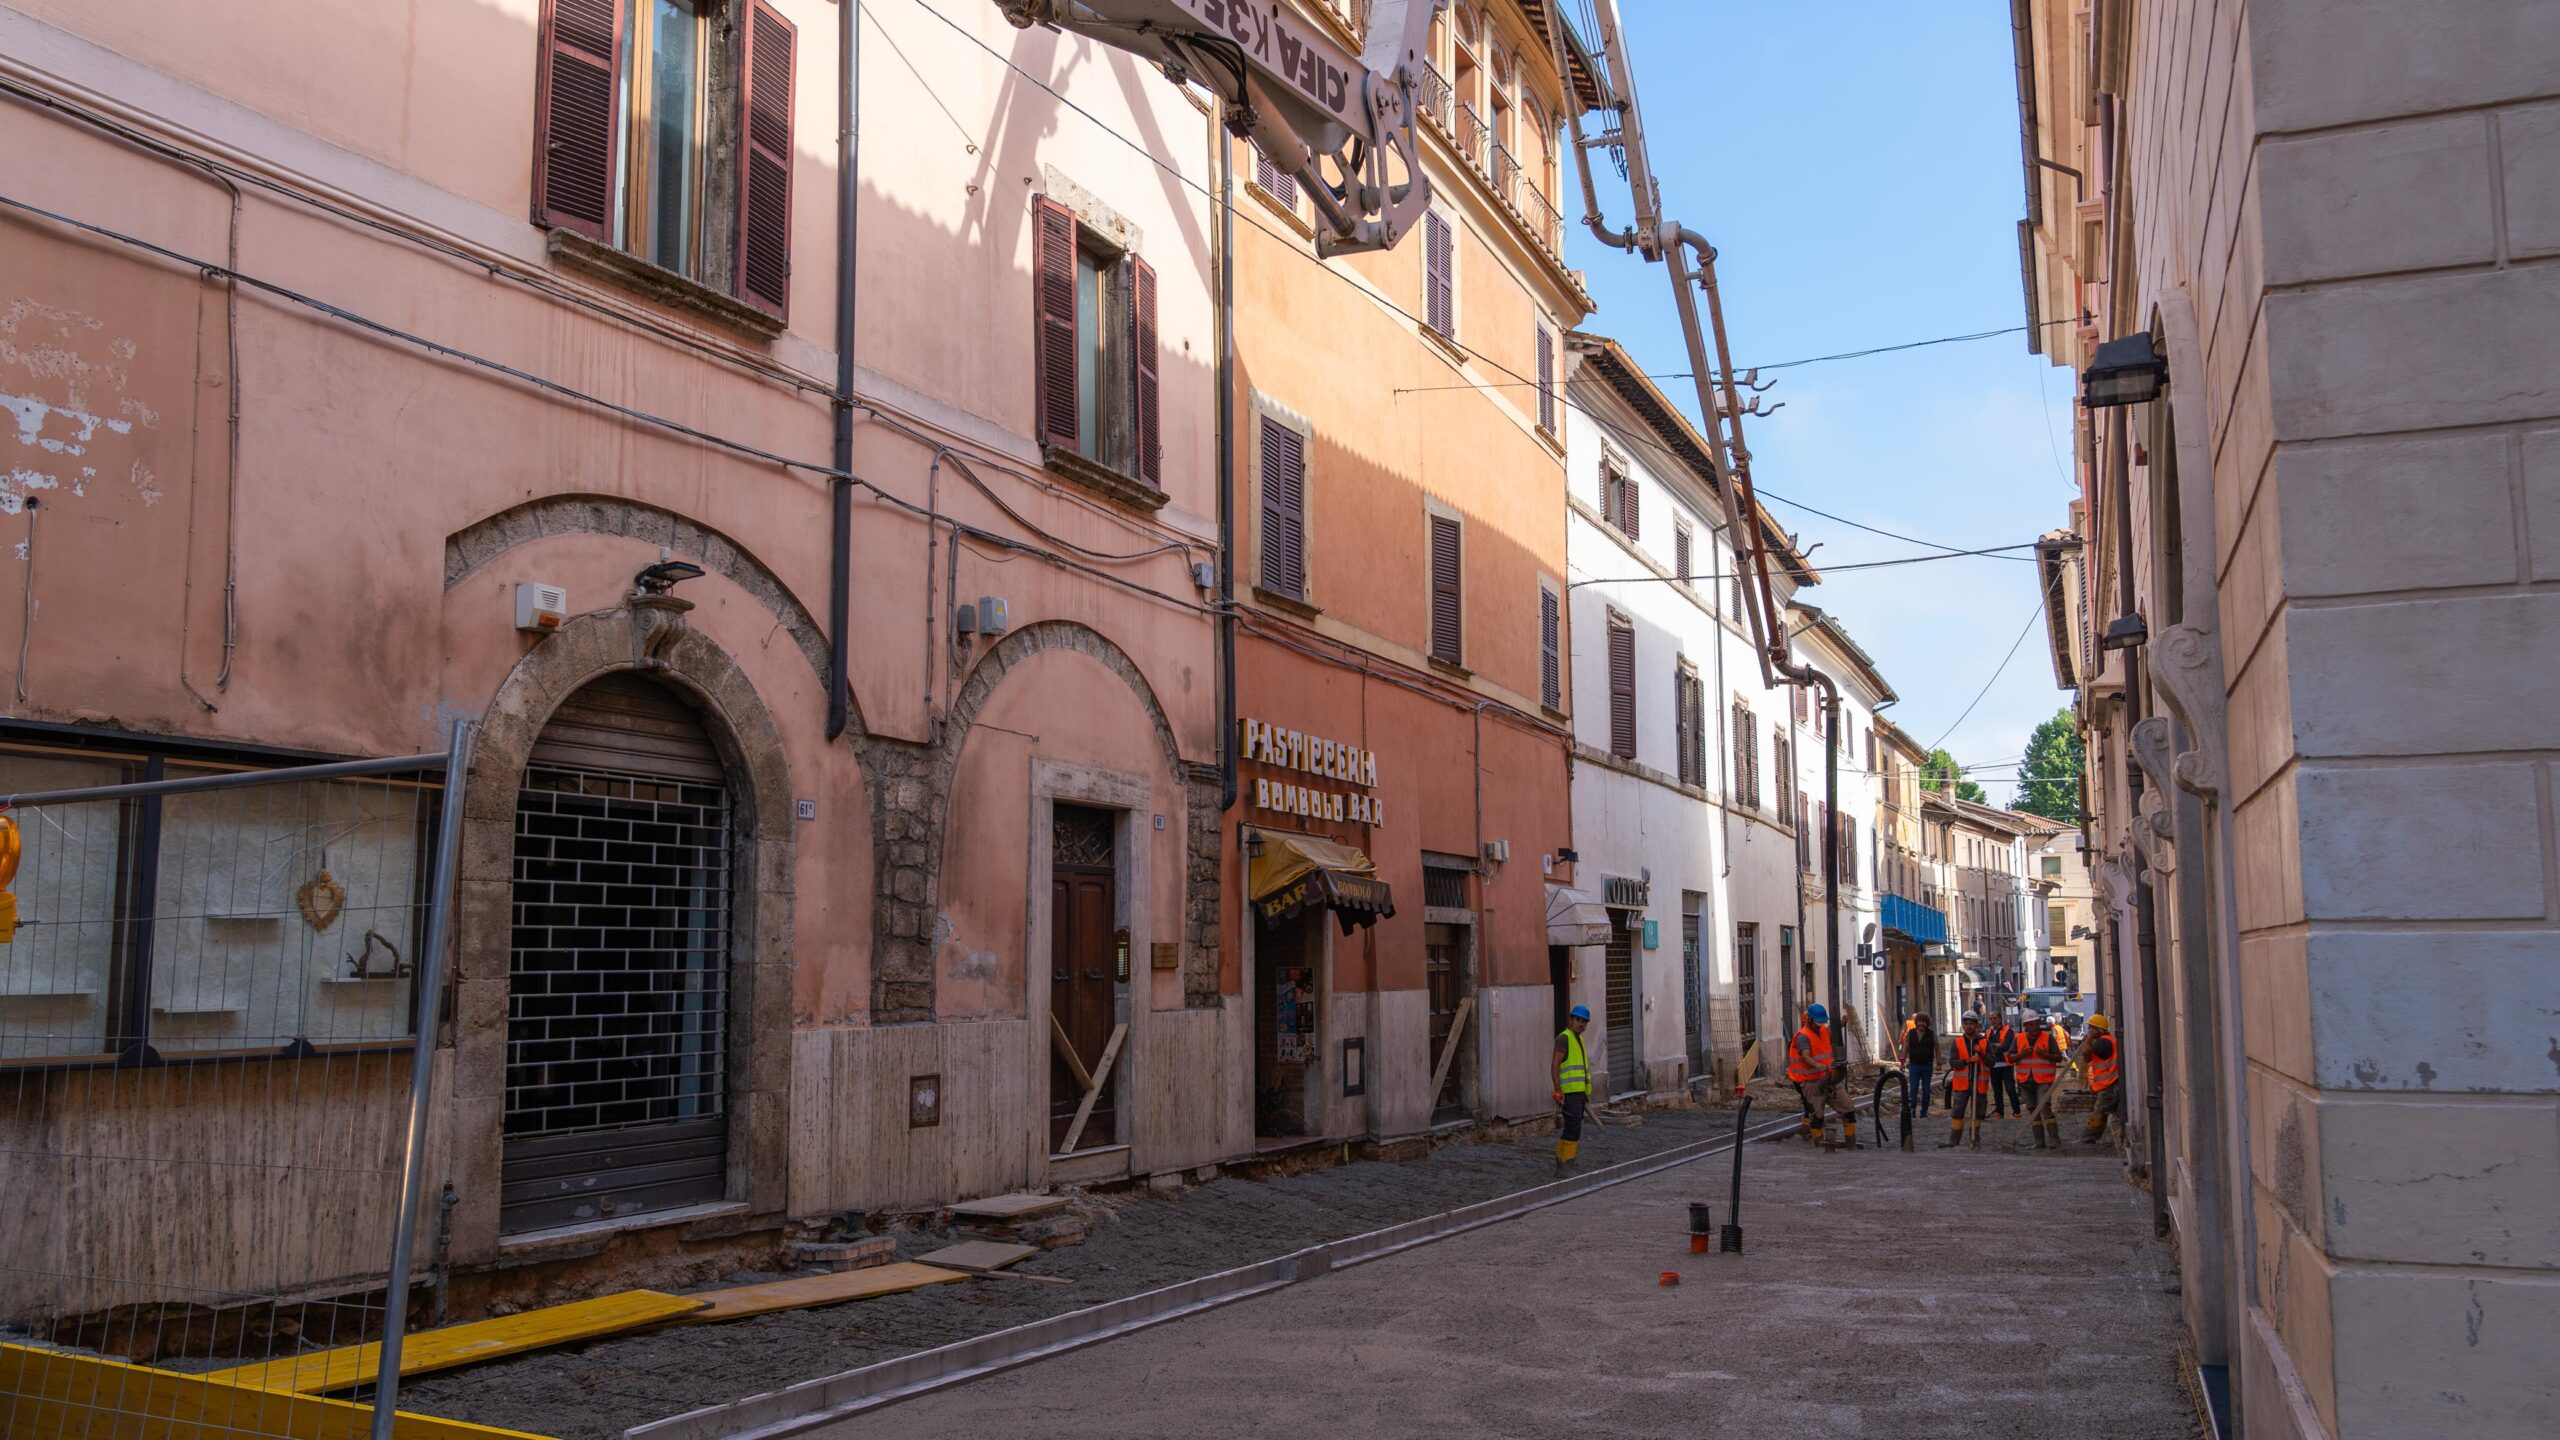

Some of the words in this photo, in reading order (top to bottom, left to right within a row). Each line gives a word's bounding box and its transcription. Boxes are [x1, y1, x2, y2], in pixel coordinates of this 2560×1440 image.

[1275, 22, 1346, 114] CIFA
[1244, 717, 1378, 788] PASTICCERIA
[1256, 778, 1343, 822] BOMBOLO
[1348, 792, 1384, 828] BAR
[1266, 883, 1307, 917] BAR
